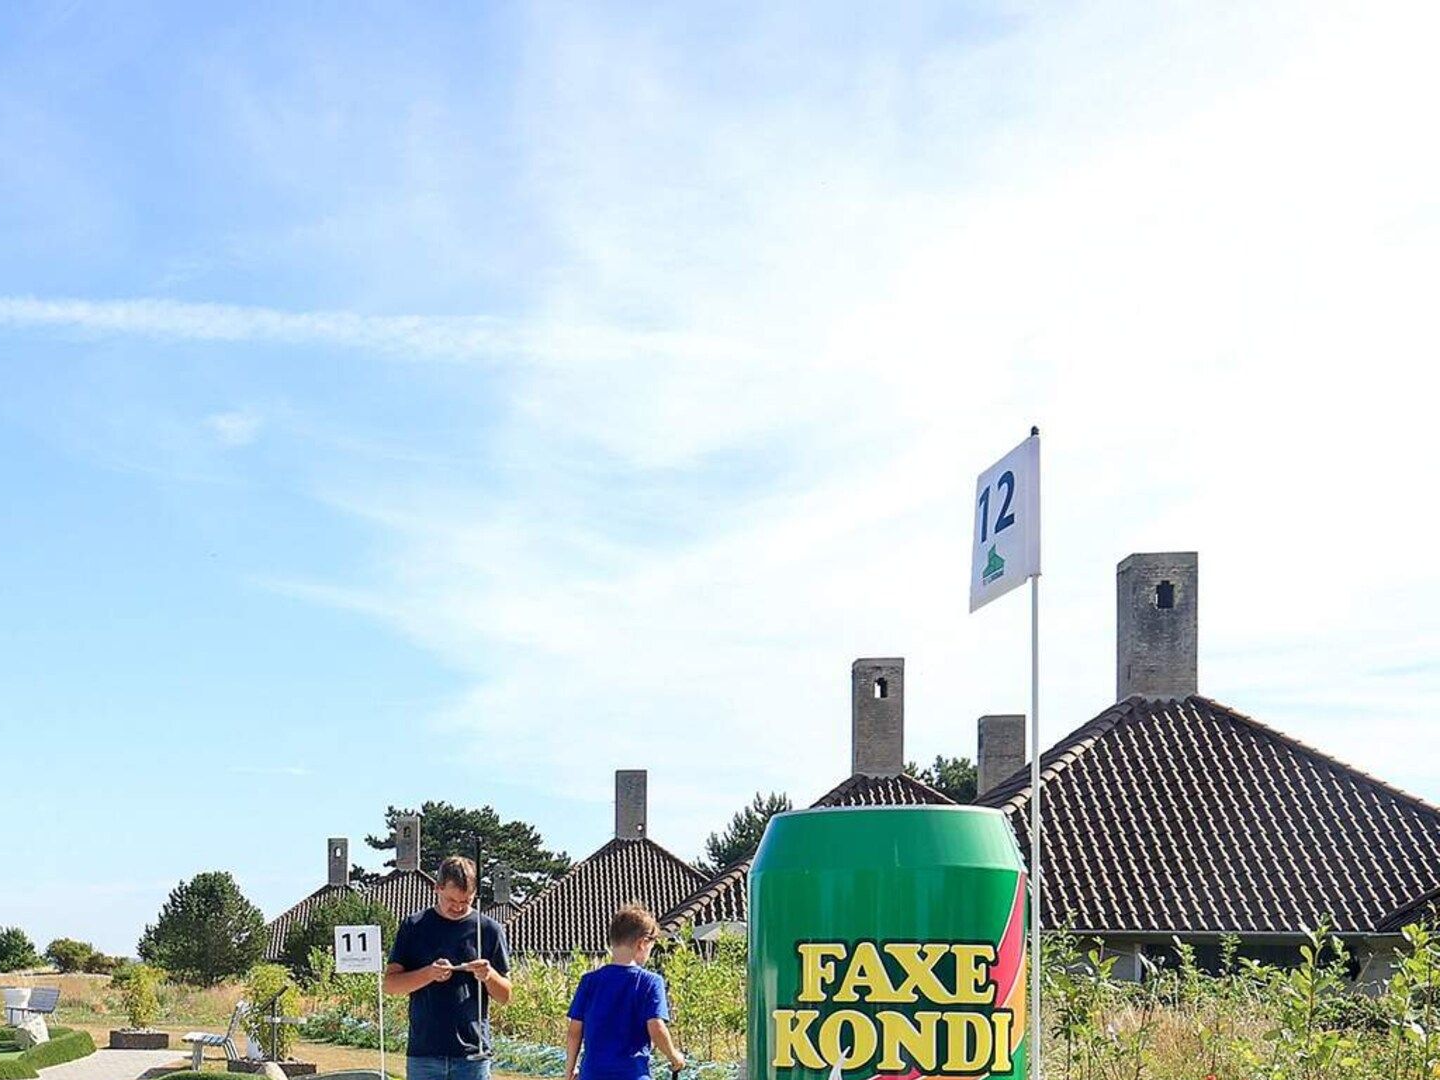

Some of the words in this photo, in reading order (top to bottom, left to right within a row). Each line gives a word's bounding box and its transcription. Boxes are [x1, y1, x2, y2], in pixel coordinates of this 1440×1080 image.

[979, 470, 1015, 543] 12
[341, 932, 367, 952] 11
[796, 941, 998, 1004] FAXE
[771, 1009, 1013, 1071] KONDI
